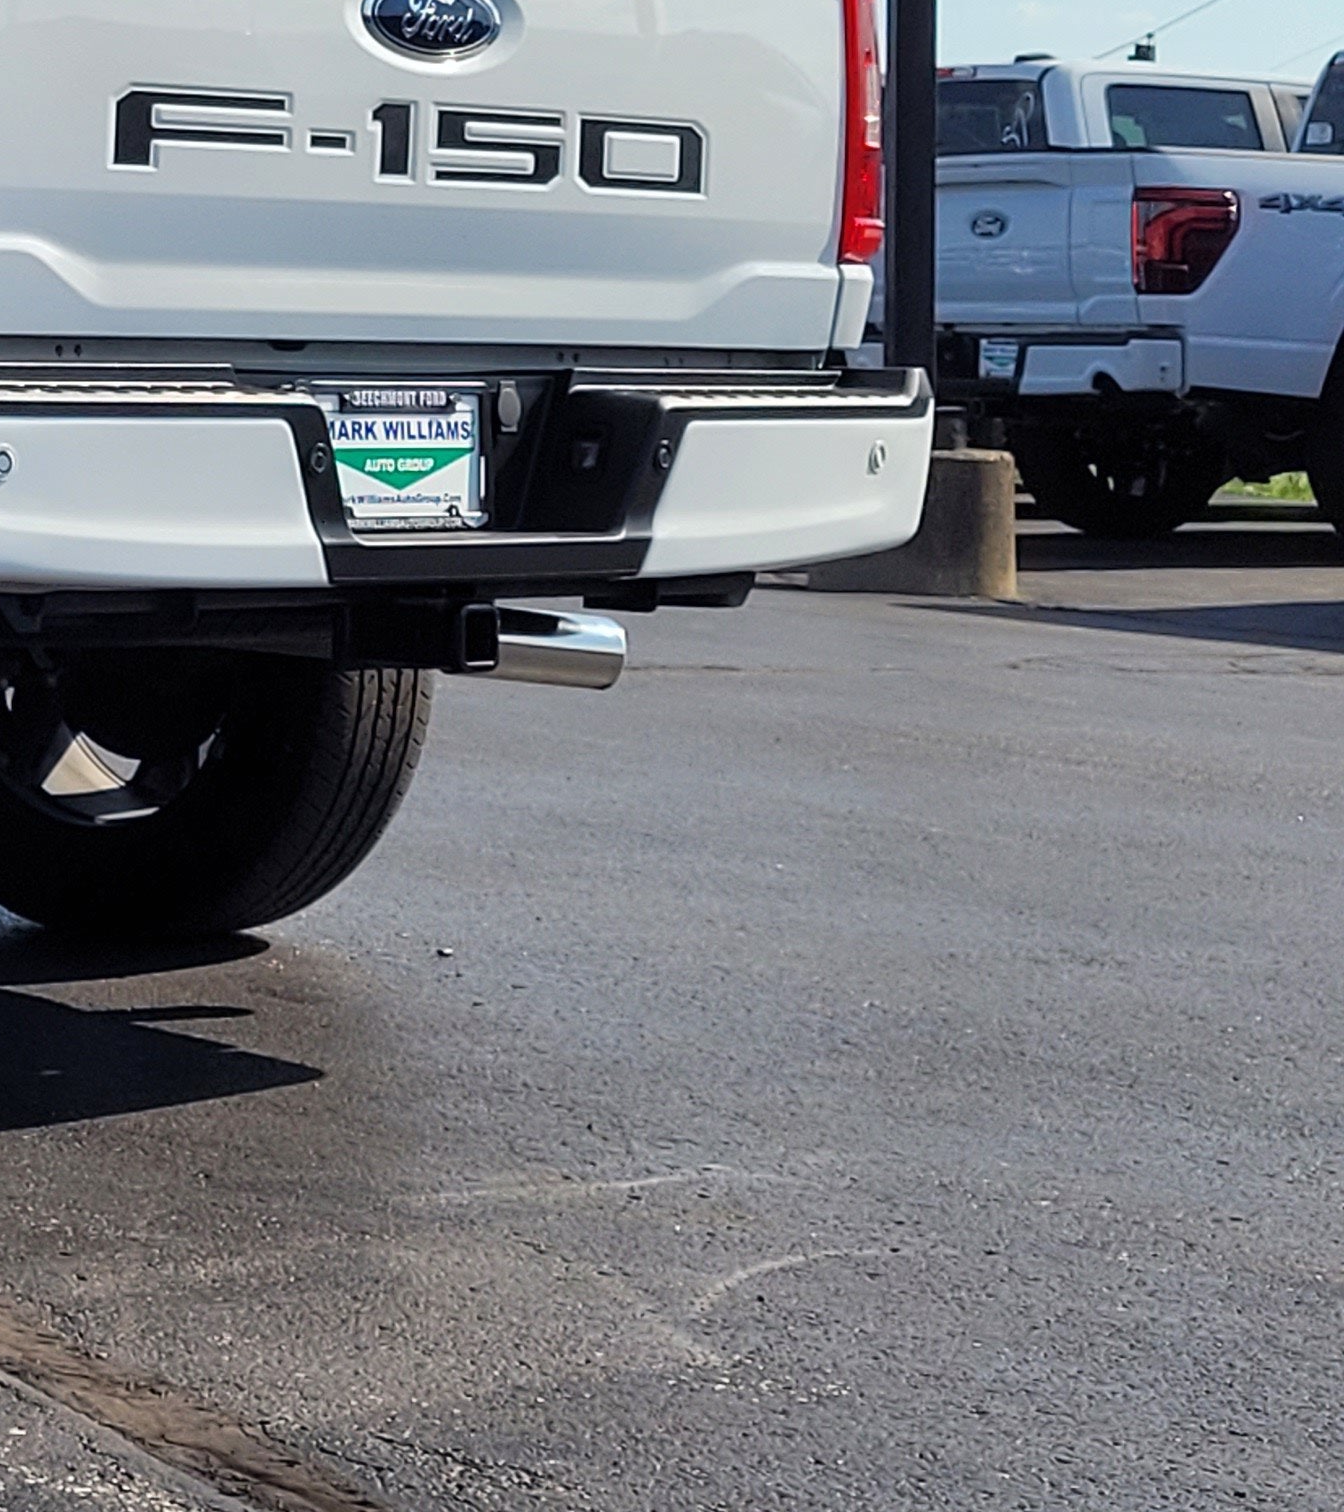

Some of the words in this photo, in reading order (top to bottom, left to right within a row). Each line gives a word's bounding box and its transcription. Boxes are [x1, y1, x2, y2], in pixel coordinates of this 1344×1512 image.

[110, 85, 706, 197] F-150
[419, 390, 447, 407] FORD
[383, 419, 471, 441] WILLIAMS
[365, 458, 395, 472] AUTO
[397, 457, 435, 472] GROUP
